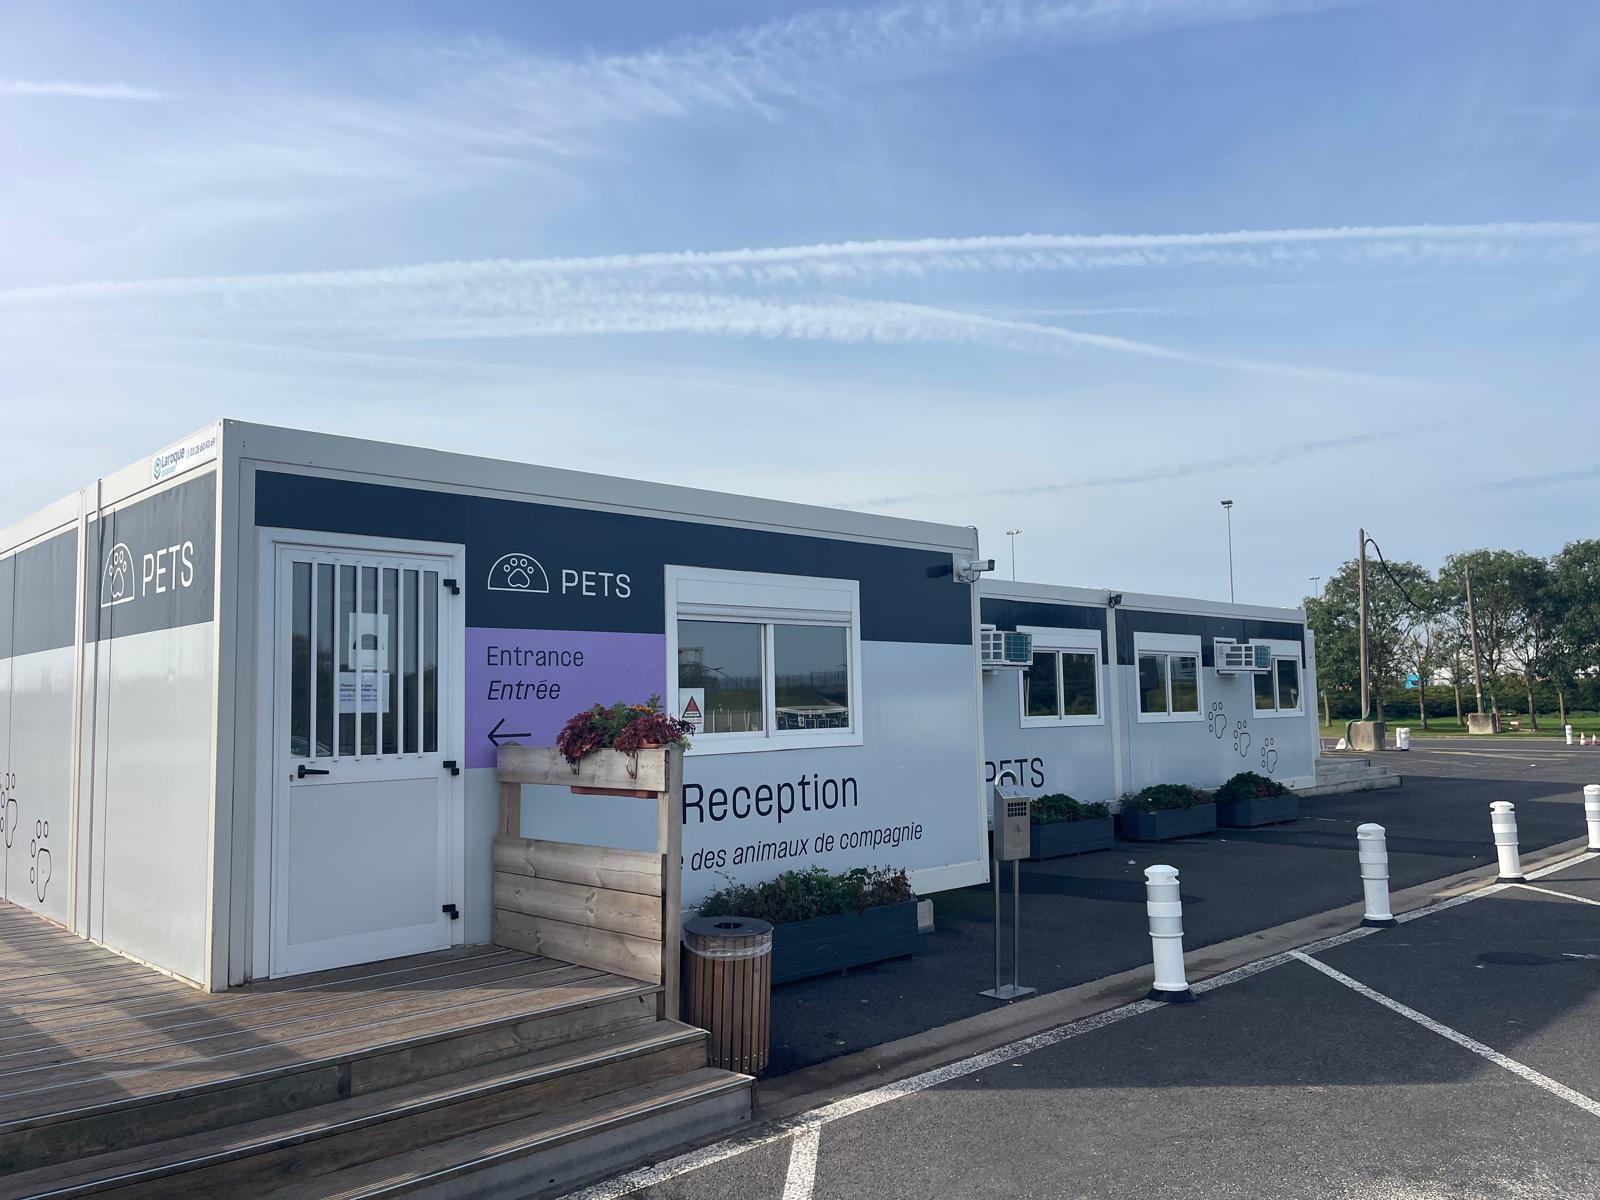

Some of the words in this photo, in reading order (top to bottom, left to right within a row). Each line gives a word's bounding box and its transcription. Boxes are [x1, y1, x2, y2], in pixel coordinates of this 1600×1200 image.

[161, 447, 185, 468] Laroque
[142, 541, 194, 597] PETS
[562, 569, 631, 598] PETS
[487, 646, 584, 667] Entrance
[487, 679, 561, 700] Entrée
[682, 774, 858, 824] Reception
[691, 849, 726, 871] des
[732, 837, 809, 865] animaux
[814, 832, 834, 853] de
[839, 821, 923, 850] compagnie
